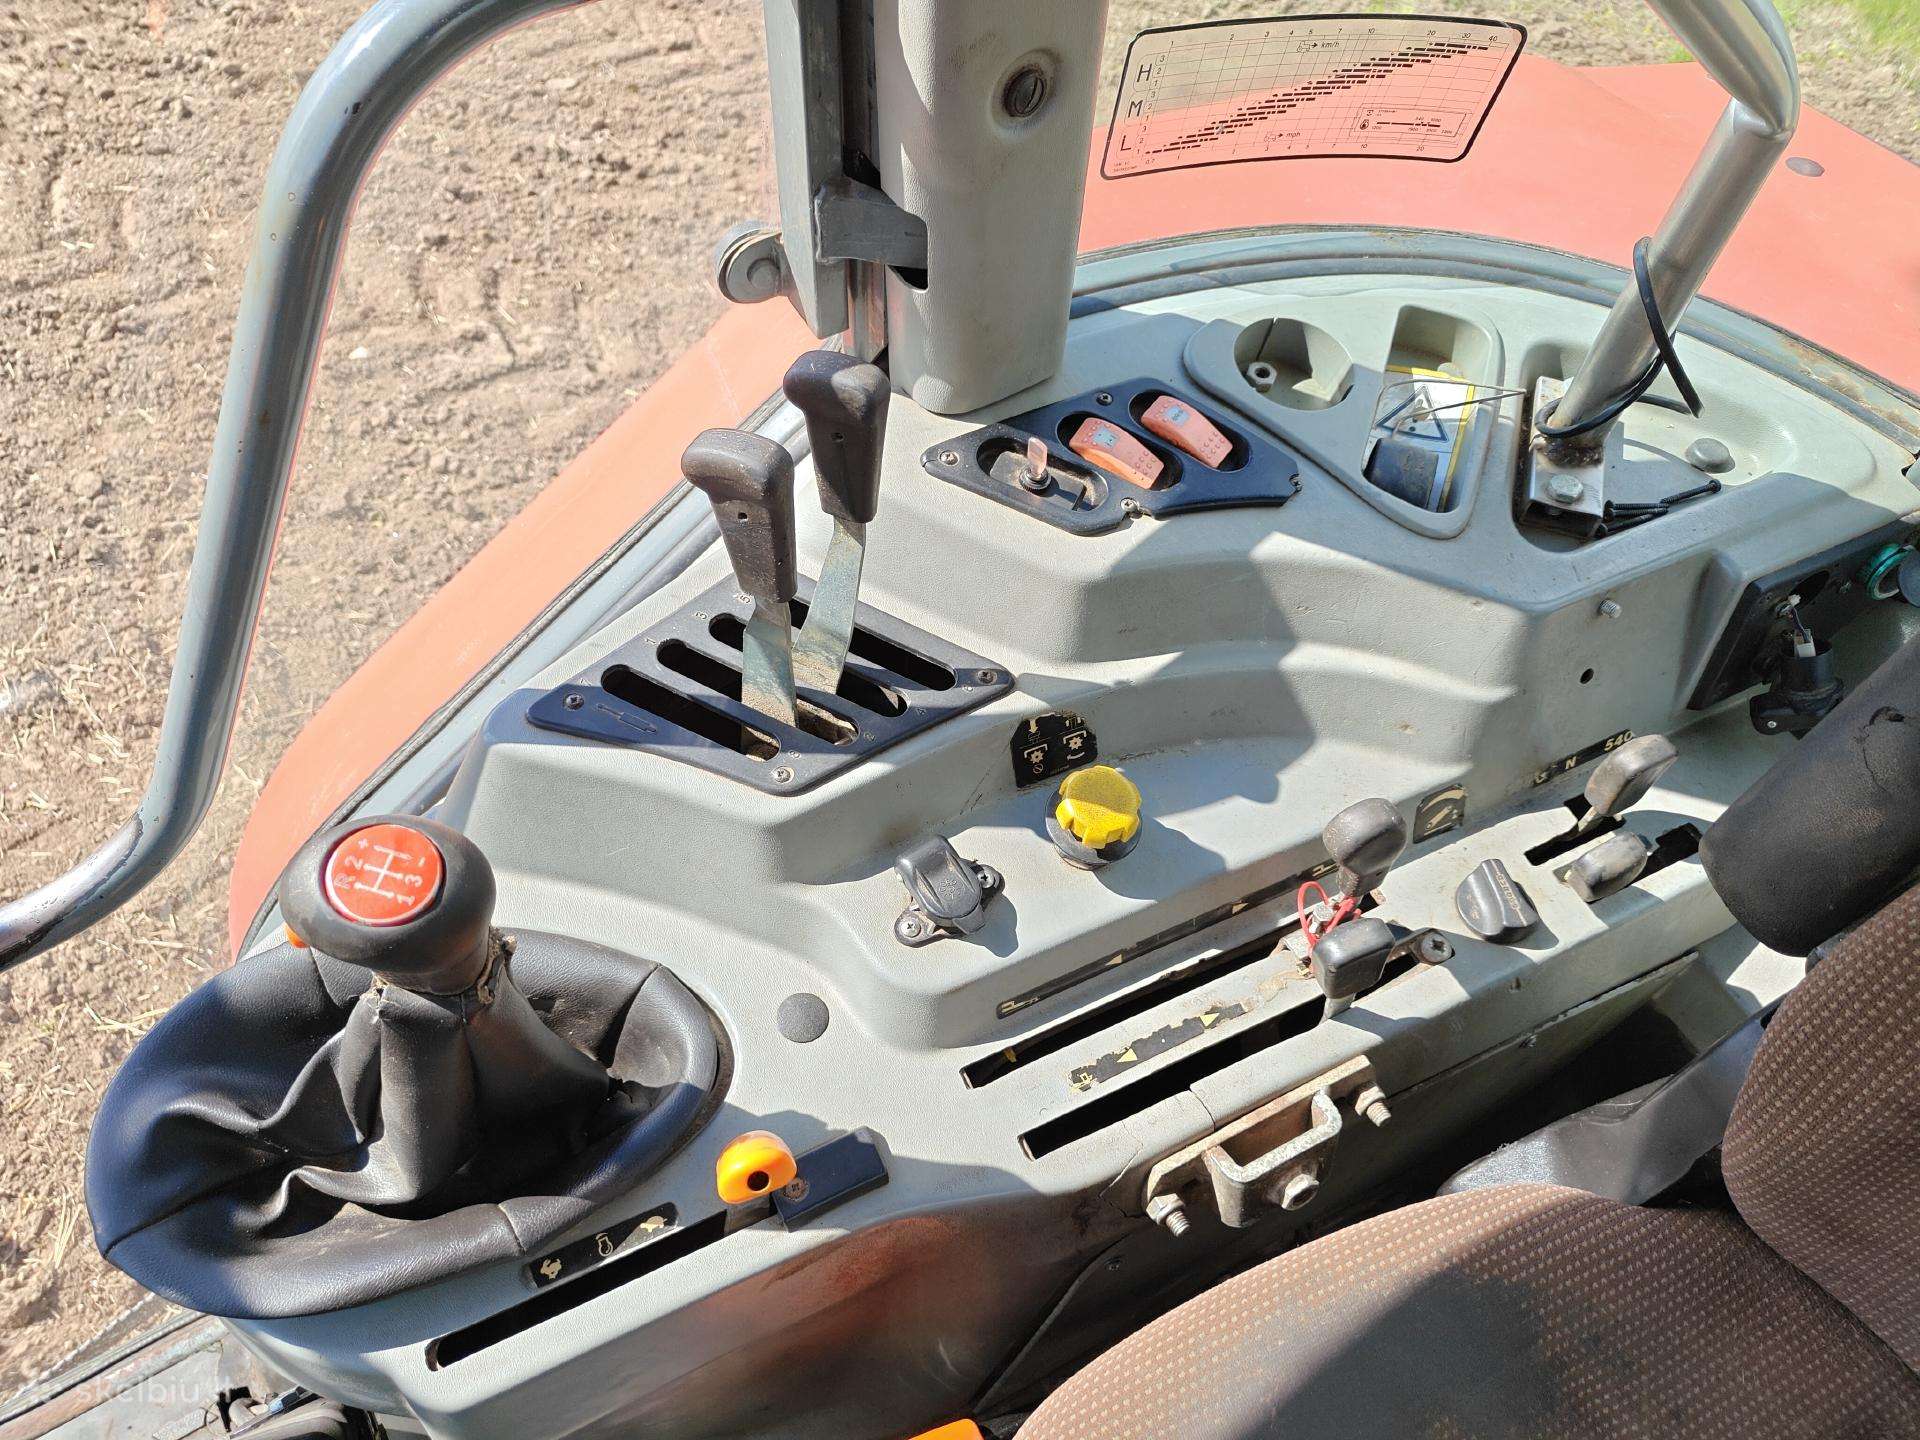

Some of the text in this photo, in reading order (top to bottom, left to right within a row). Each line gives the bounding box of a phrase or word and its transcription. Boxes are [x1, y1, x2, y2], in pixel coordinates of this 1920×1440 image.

[1367, 27, 1376, 35] 10
[1320, 41, 1341, 49] km/h
[1136, 63, 1153, 83] H
[1127, 99, 1144, 118] M
[1120, 134, 1132, 152] L
[1416, 144, 1425, 152] 20
[1564, 755, 1578, 770] N
[1603, 730, 1634, 752] 540
[344, 854, 364, 871] 2
[333, 872, 356, 890] R
[403, 873, 423, 888] 3
[395, 893, 416, 906] 1
